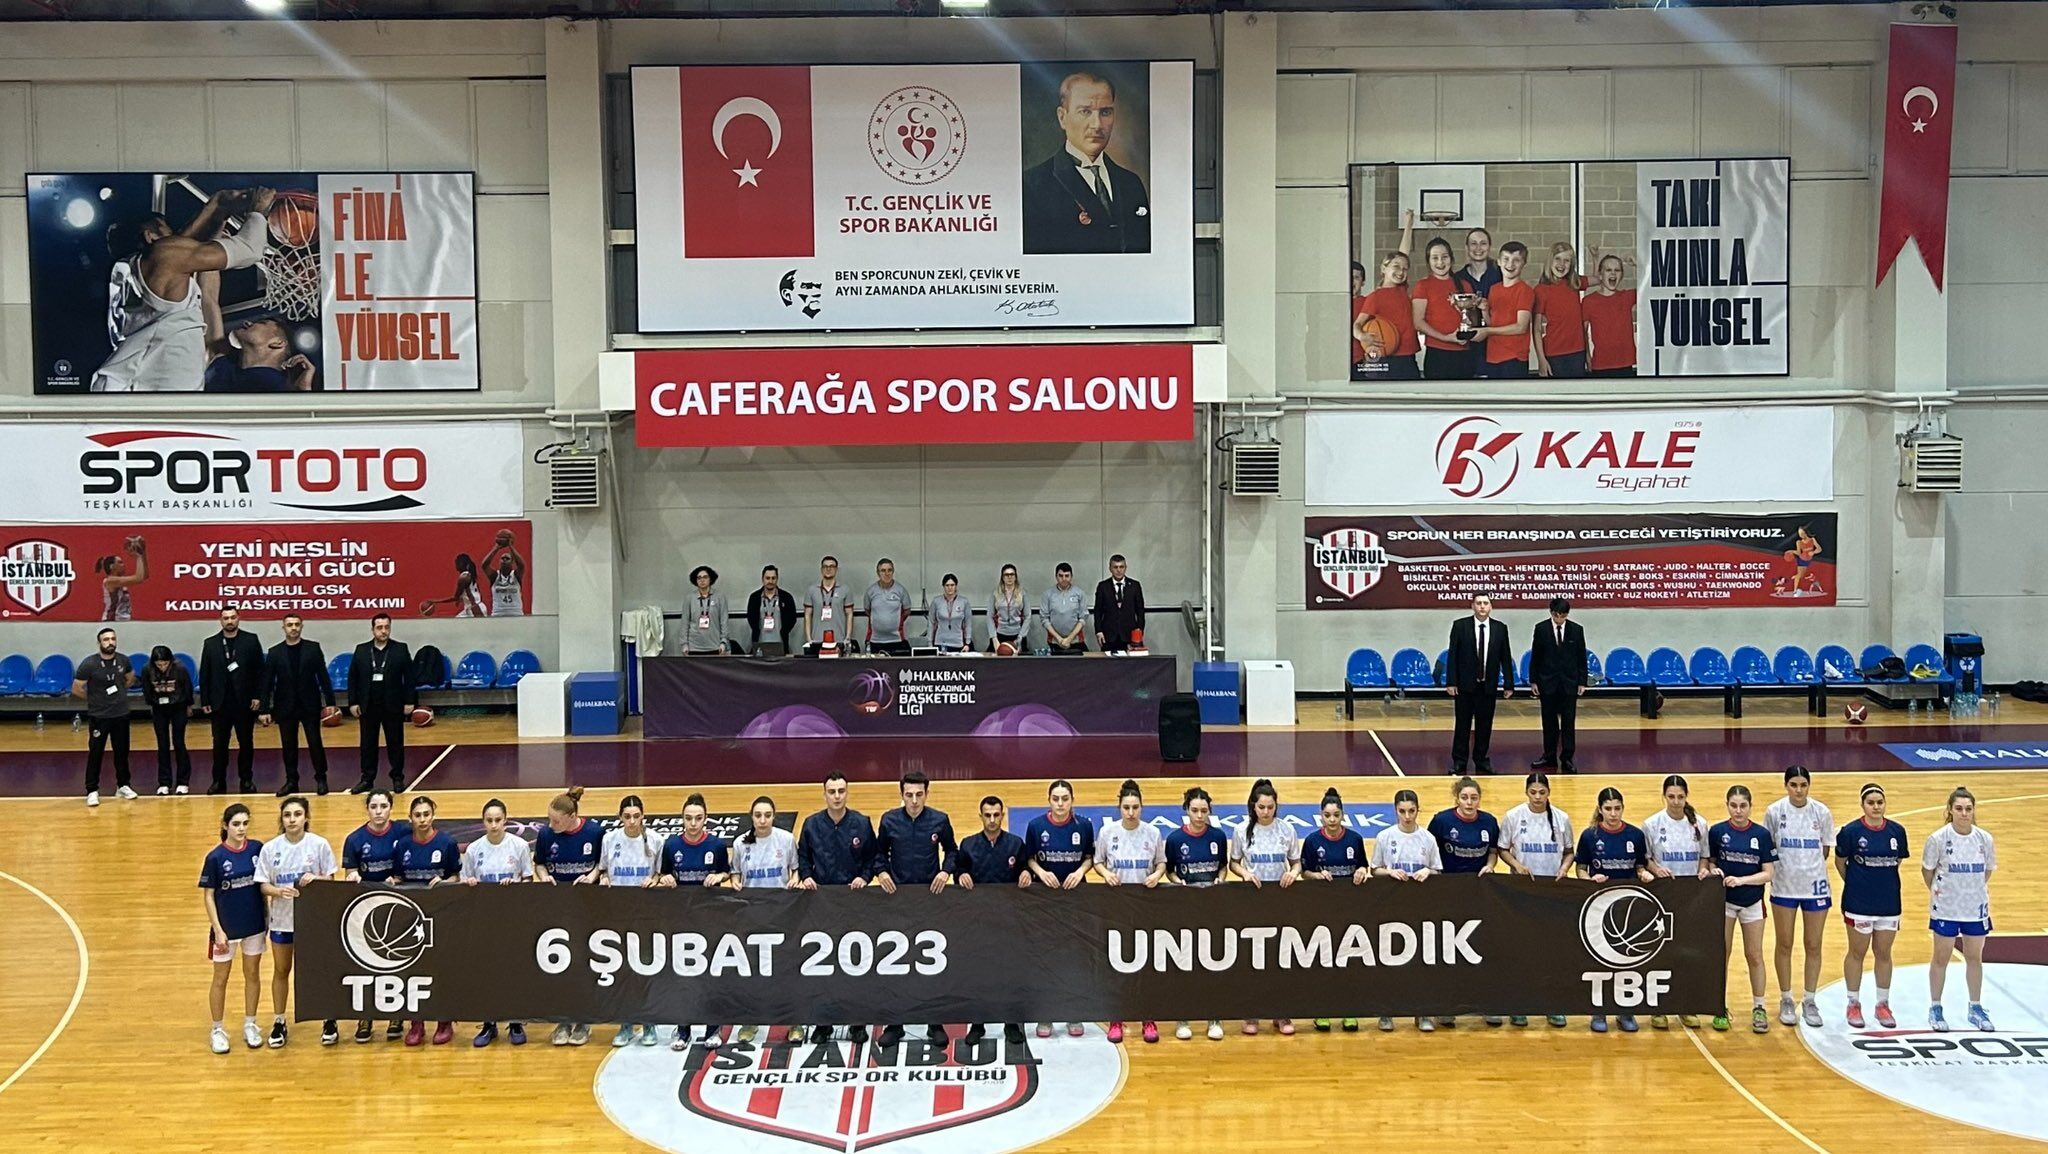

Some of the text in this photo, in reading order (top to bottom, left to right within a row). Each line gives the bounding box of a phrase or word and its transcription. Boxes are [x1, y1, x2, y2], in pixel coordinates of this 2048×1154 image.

[845, 191, 992, 214] T.C. GENÇLİK VE
[333, 187, 407, 241] FİNA
[840, 214, 998, 233] SPOR BAKANLIĞI
[1651, 238, 1749, 287] MINLA
[335, 253, 374, 300] LE
[835, 267, 1021, 281] BEN SPORCUNUN ZEKİ, ÇEVİK VE
[835, 282, 1059, 296] AYNI ZAMANDA AHLAKLISINI SEVERİM.
[1651, 294, 1771, 346] YÜKSEL
[335, 307, 460, 361] YÜKSEL
[650, 373, 1179, 417] CAFERAĞA SPOR SALONU
[1534, 430, 1701, 468] KALE
[80, 448, 427, 494] SPOR TOTO
[1596, 474, 1692, 492] Seyahat
[84, 498, 253, 511] TEŞKİLAT BAŞKANLIĞI
[1387, 526, 1785, 542] SPORUN HER BRANŞINDA GELECEĞİ YETİŞTİRİYORUZ.
[201, 538, 368, 558] YENİ NESLİN
[1317, 546, 1386, 564] İSTANBUL
[2, 559, 73, 578] İSTANBUL
[174, 557, 396, 579] POTADAKİ GÜCÜ
[1398, 564, 1451, 573] BASKETBOL
[1459, 564, 1506, 573] VOLEYBOL
[1515, 564, 1557, 572] HENTBOL
[1565, 564, 1578, 572] SU
[1613, 563, 1655, 573] SATRANÇ
[1663, 563, 1687, 571] JUDO
[1697, 563, 1731, 571] HALTER
[1534, 573, 1559, 581] MASA
[1599, 572, 1630, 582] GÜREŞ
[218, 584, 352, 596] İSTANBUL GSK
[1407, 583, 1450, 593] OKÇULUK
[1458, 583, 1497, 591] MODERN
[1499, 583, 1550, 591] PENTATLON
[1605, 582, 1629, 590] KICK
[1630, 582, 1655, 590] BOKS
[1705, 581, 1762, 589] TAEKWONDO
[1438, 592, 1473, 600] KARATE
[1488, 592, 1513, 600] ÜZME
[1521, 592, 1575, 600] BADMINTON
[165, 597, 405, 611] KADIN BASKETBOL TAKIMI
[914, 671, 975, 681] HALKBANK
[900, 684, 976, 692] TÜRKİYE KADINLAR
[899, 693, 976, 704] BASKETBOL
[1811, 880, 1828, 896] 12
[535, 919, 1483, 987] 6 ŞUBAT 2023 UNUTMADIK
[342, 975, 433, 1013] TBF
[1581, 970, 1672, 1007] TBF
[713, 1070, 820, 1086] GENÇLİK
[908, 1067, 1008, 1082] KULÜBÜ
